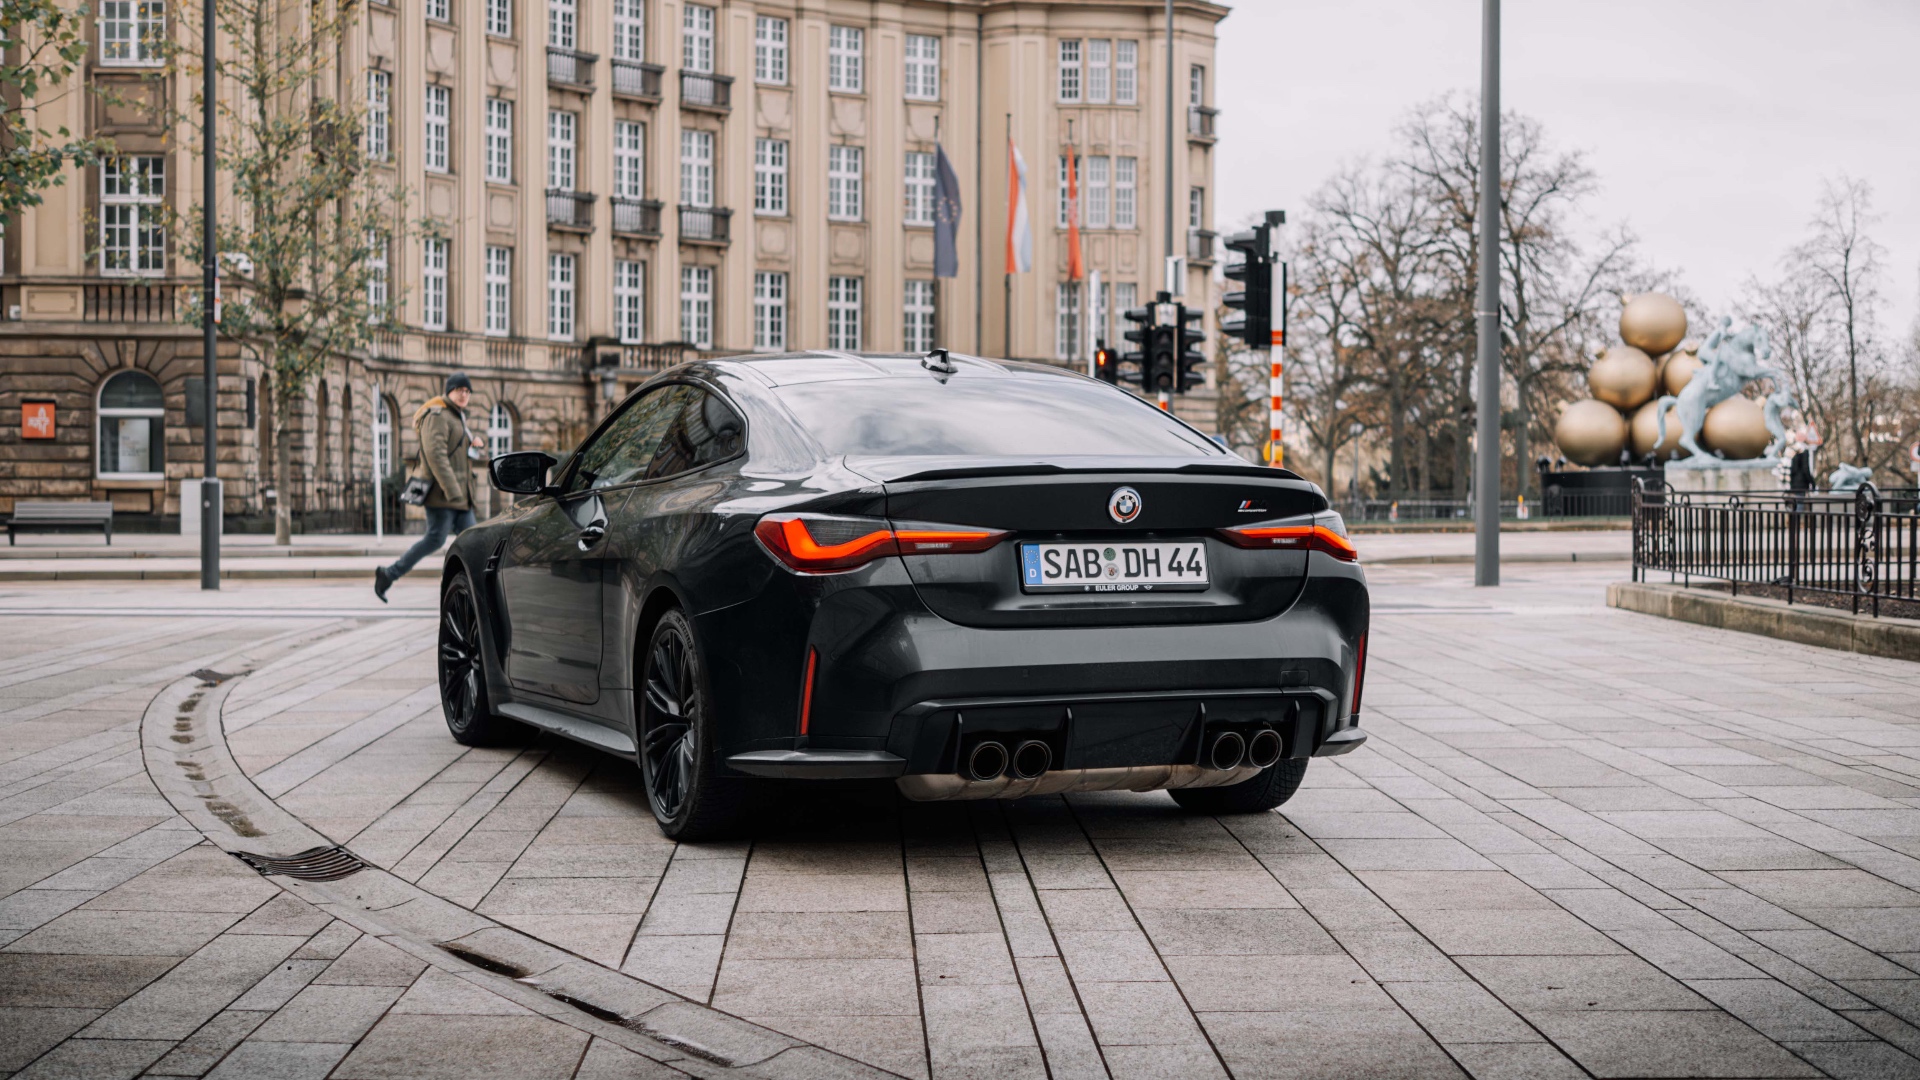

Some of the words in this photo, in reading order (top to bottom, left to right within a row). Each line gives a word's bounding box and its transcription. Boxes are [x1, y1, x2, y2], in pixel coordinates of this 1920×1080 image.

[1044, 549, 1102, 579] SAB
[1122, 548, 1161, 578] DH
[1168, 547, 1203, 577] 44
[1029, 568, 1037, 578] D
[1095, 584, 1116, 592] EULER
